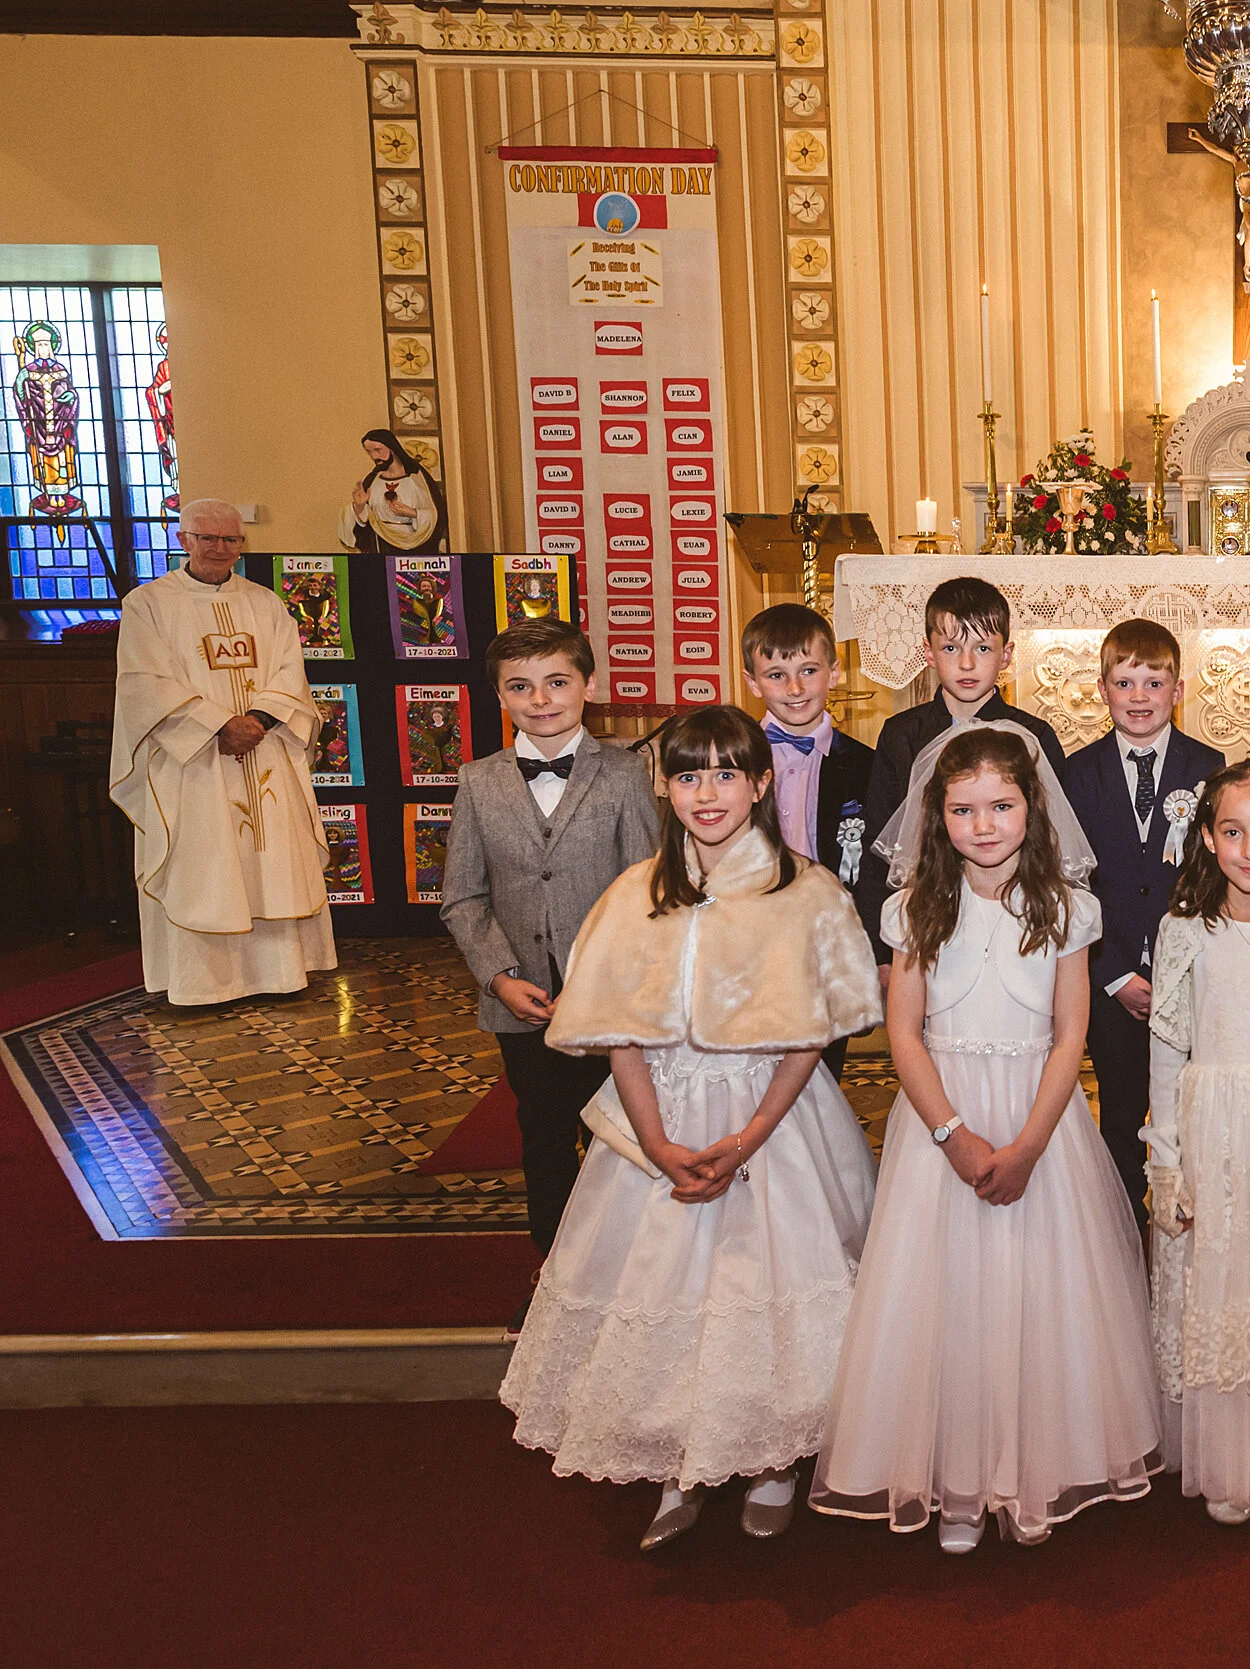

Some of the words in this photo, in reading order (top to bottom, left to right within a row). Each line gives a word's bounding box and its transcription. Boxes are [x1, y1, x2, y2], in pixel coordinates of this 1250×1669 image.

[509, 164, 664, 194] CONFIRMATION
[671, 167, 712, 195] DAY
[589, 261, 606, 272] The
[584, 280, 600, 291] The
[597, 335, 642, 343] MADELENA
[613, 539, 646, 547] CATHAL
[399, 558, 447, 571] Hannah
[511, 558, 552, 570] Sadbh
[408, 648, 457, 656] 17-10-2021
[311, 687, 341, 698] arán
[410, 687, 454, 699] Eimear
[416, 776, 459, 784] 17-10-202
[319, 806, 351, 820] isling
